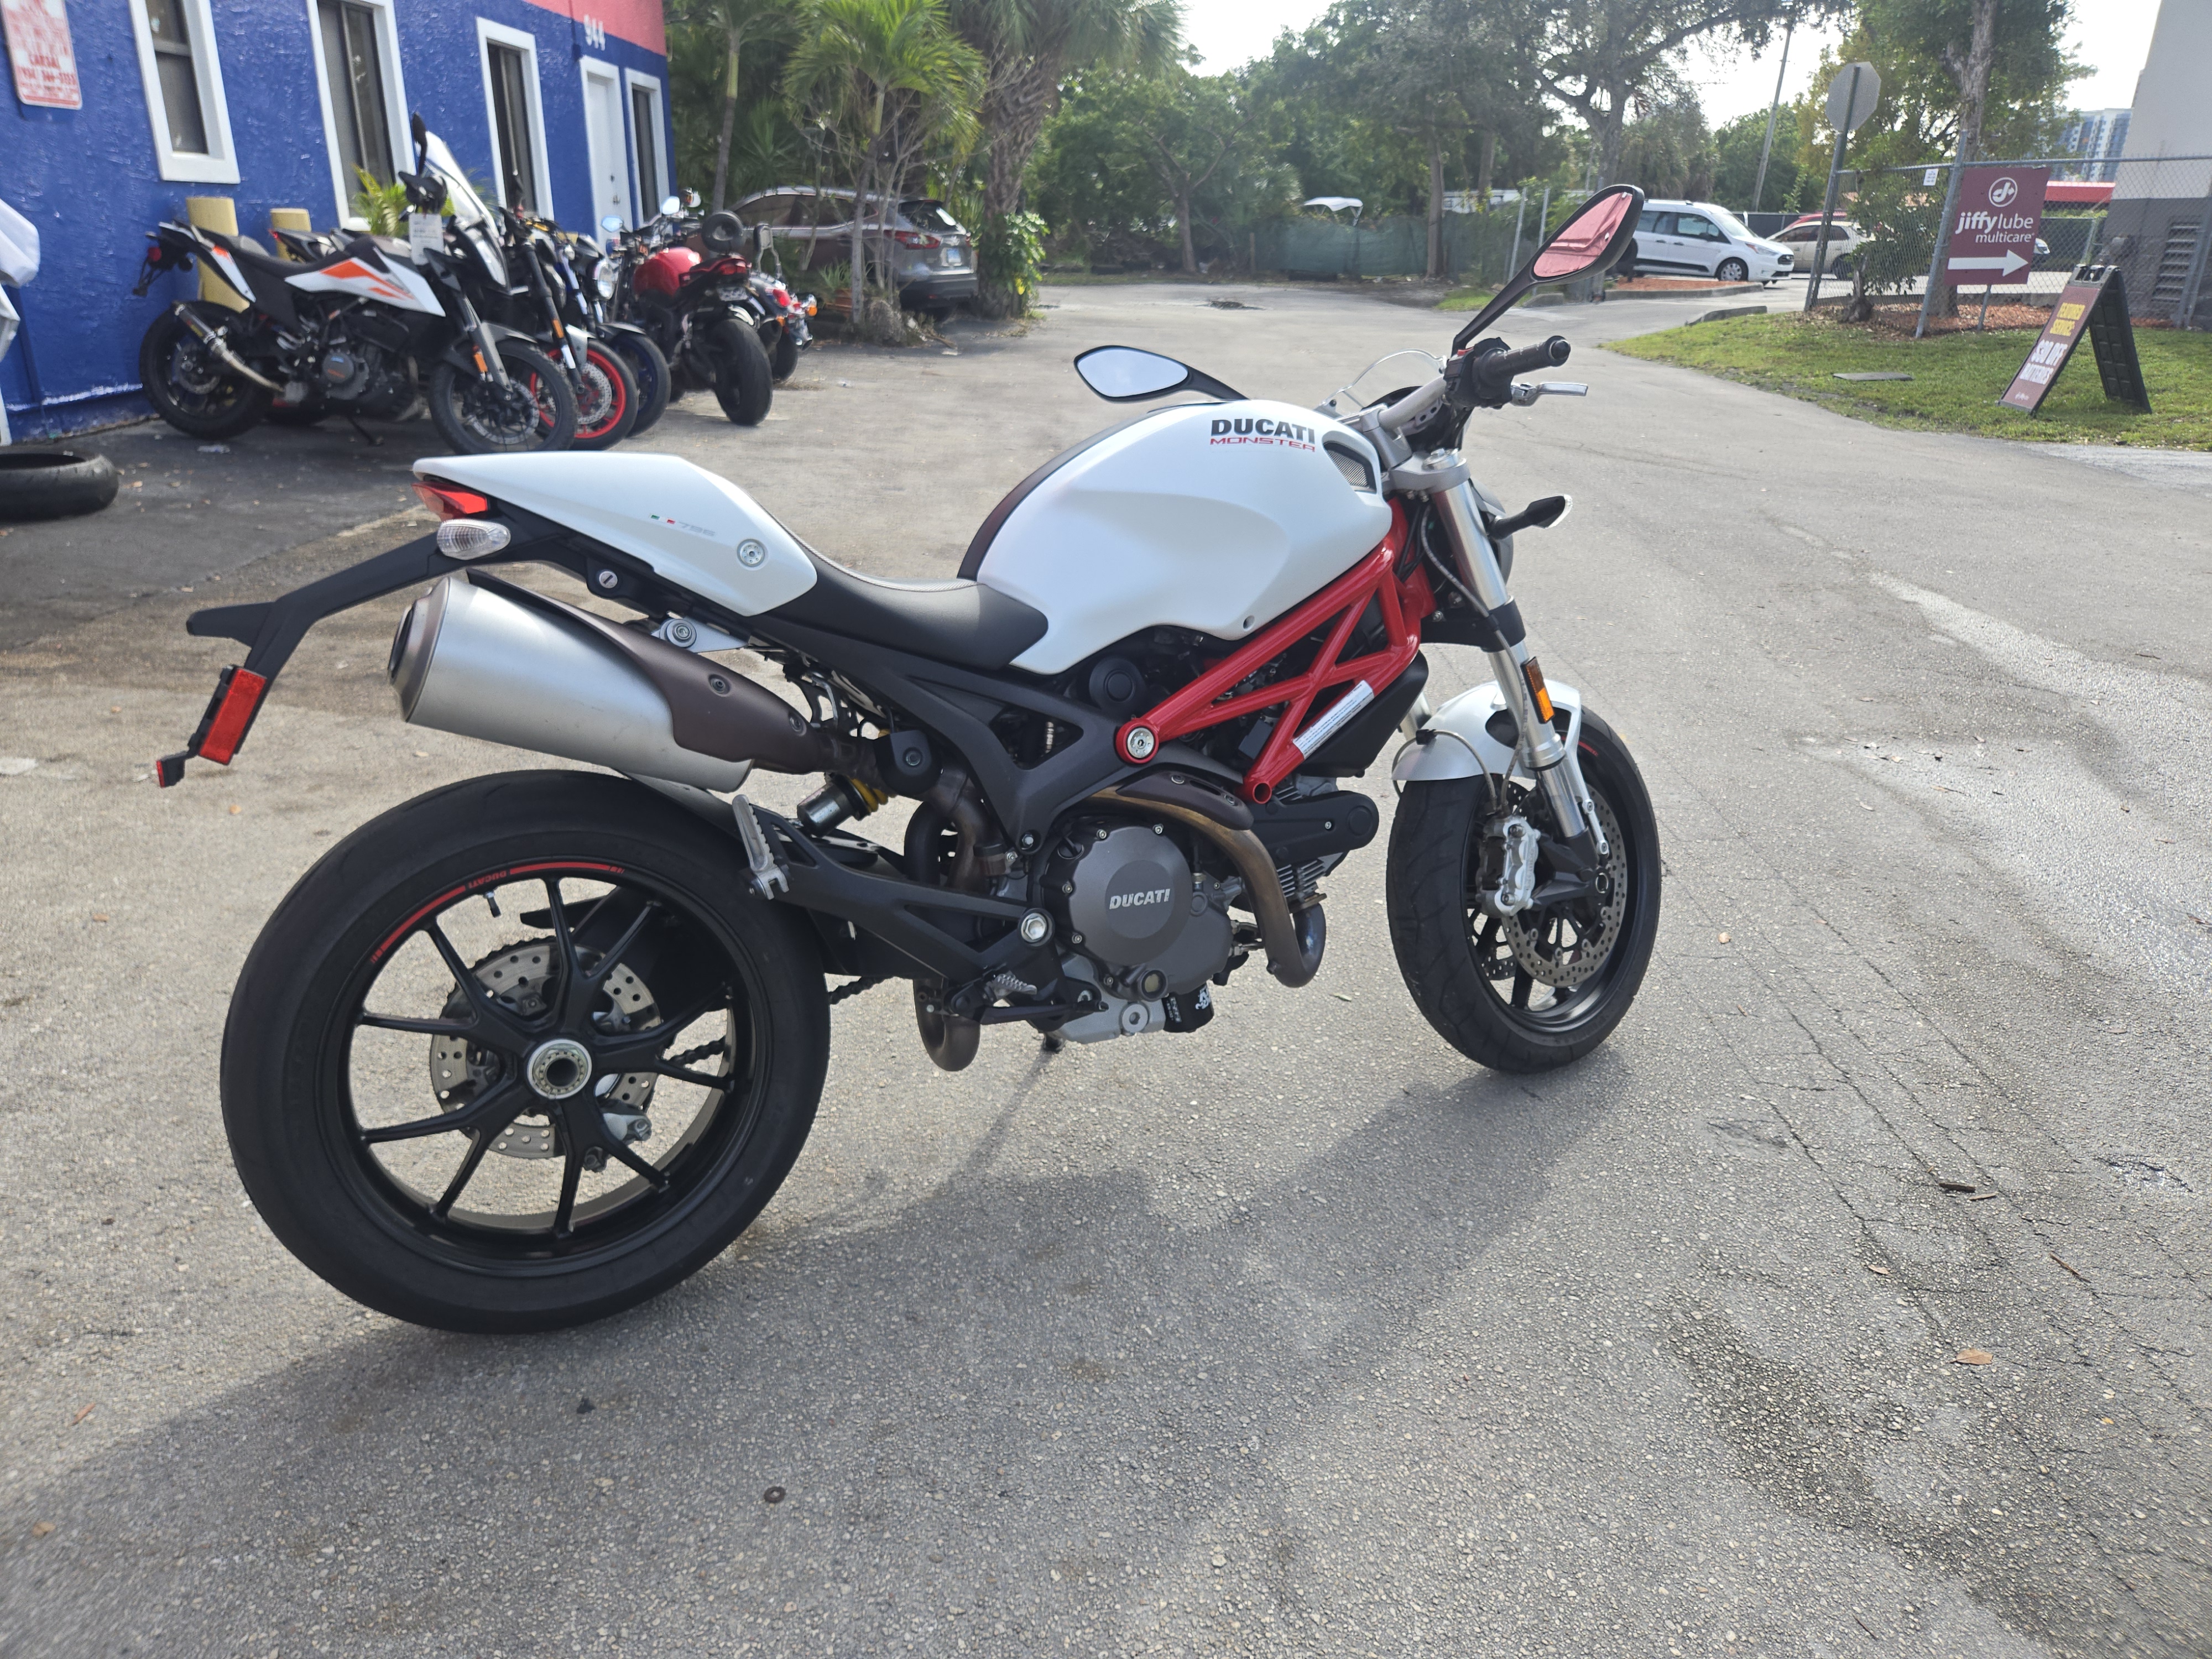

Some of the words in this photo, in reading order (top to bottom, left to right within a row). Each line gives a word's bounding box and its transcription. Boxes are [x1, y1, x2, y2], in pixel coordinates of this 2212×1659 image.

[584, 14, 605, 50] 944
[1211, 419, 1315, 445] DUCATI
[1210, 437, 1316, 452] MONSTER
[468, 870, 507, 889] DUCATI
[1109, 888, 1171, 909] DUCATI
